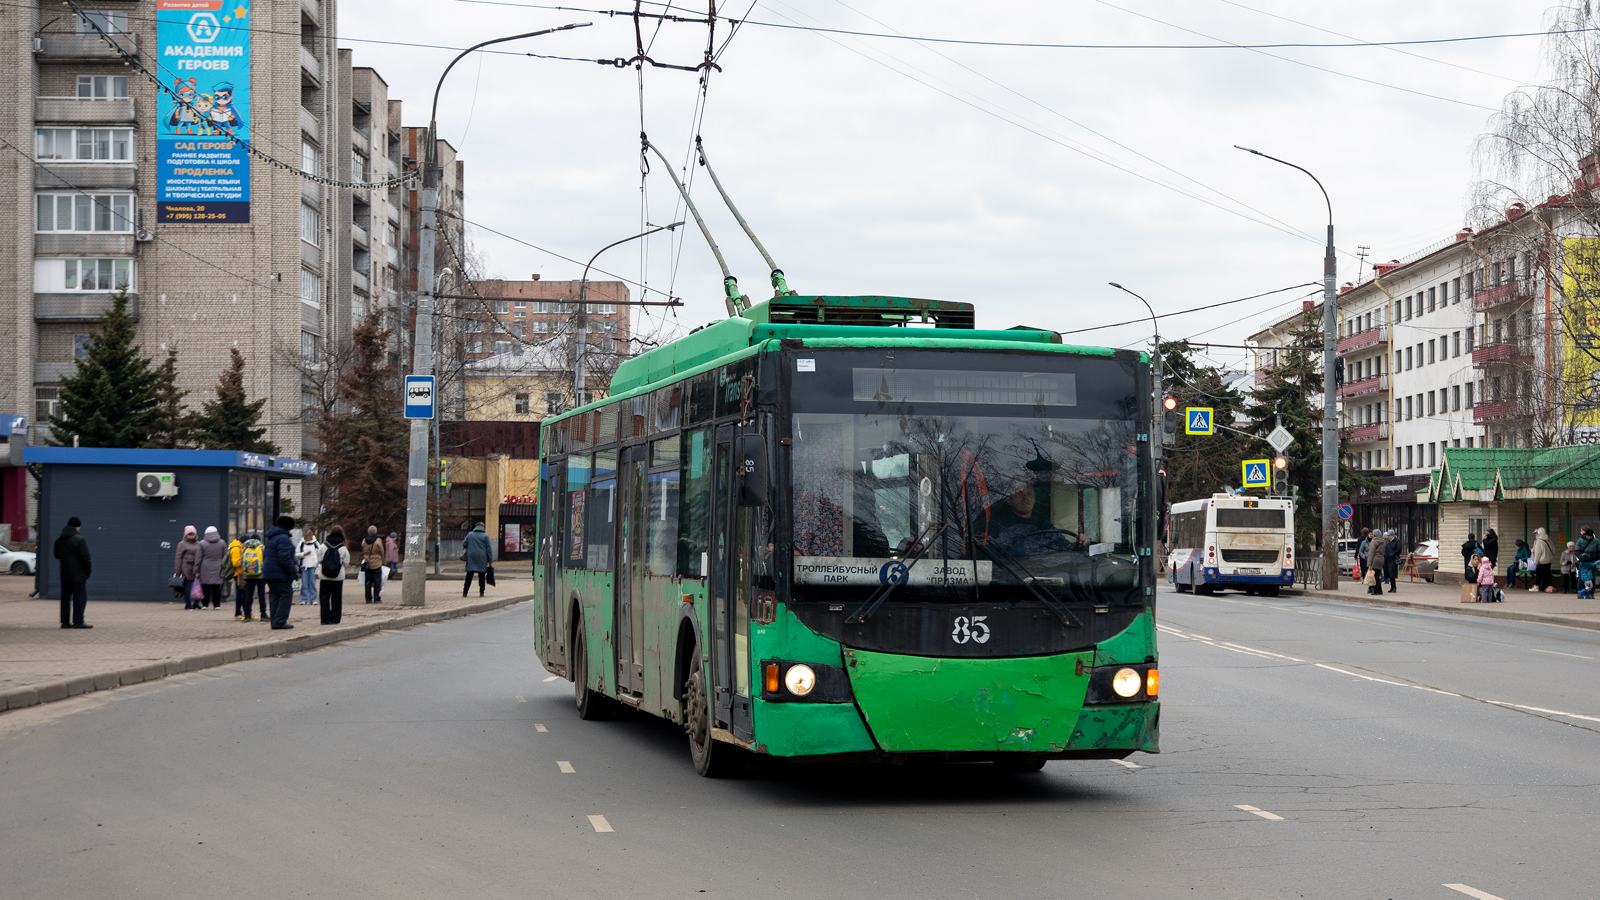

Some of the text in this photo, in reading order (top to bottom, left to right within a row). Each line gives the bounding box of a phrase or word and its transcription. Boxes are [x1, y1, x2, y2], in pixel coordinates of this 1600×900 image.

[164, 46, 244, 58] АКАДЕМИЯ
[178, 60, 230, 70] ГЕРОЕВ
[174, 142, 196, 150] САД
[174, 168, 234, 176] ПРОДЛЕНКА
[745, 460, 754, 473] 85
[796, 564, 878, 574] ТРОЛЛЕЙБУСНЫЙ
[887, 561, 903, 585] 6
[934, 566, 966, 576] ЗАВОД
[823, 574, 849, 583] ПАРК
[952, 616, 990, 644] 85
